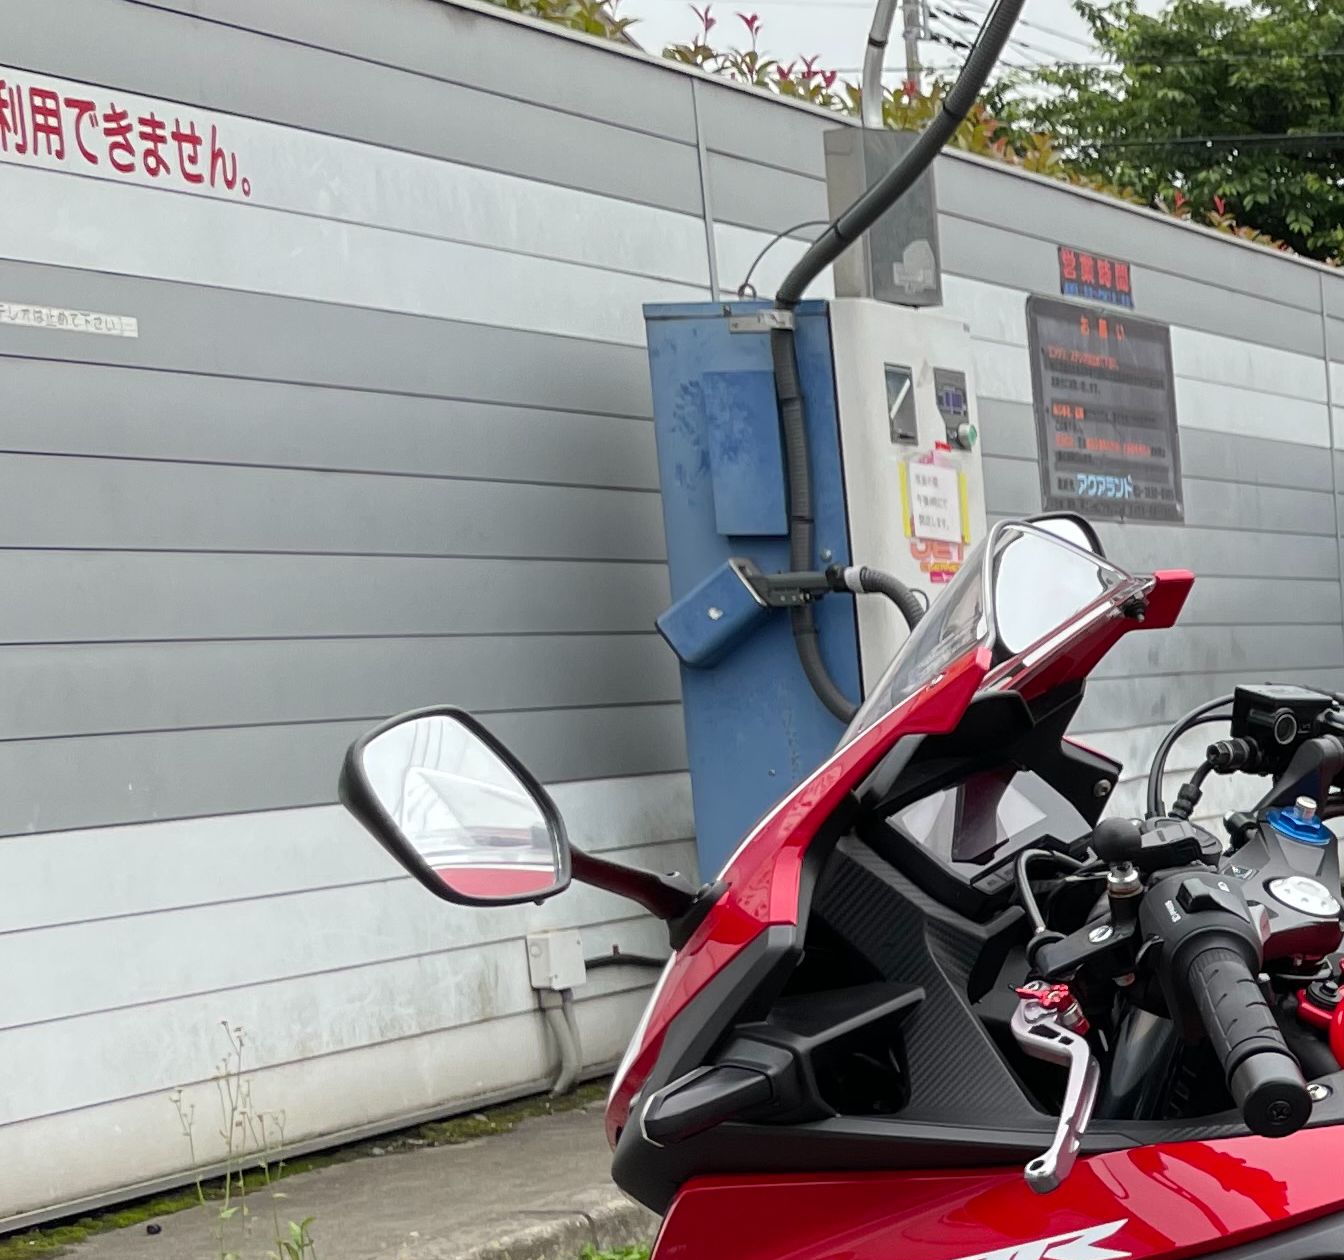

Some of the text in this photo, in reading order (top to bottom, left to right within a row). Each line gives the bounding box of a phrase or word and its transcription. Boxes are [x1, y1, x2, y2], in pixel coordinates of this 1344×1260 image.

[0, 79, 251, 197] 利用できません。
[1076, 471, 1135, 500] アクアランド
